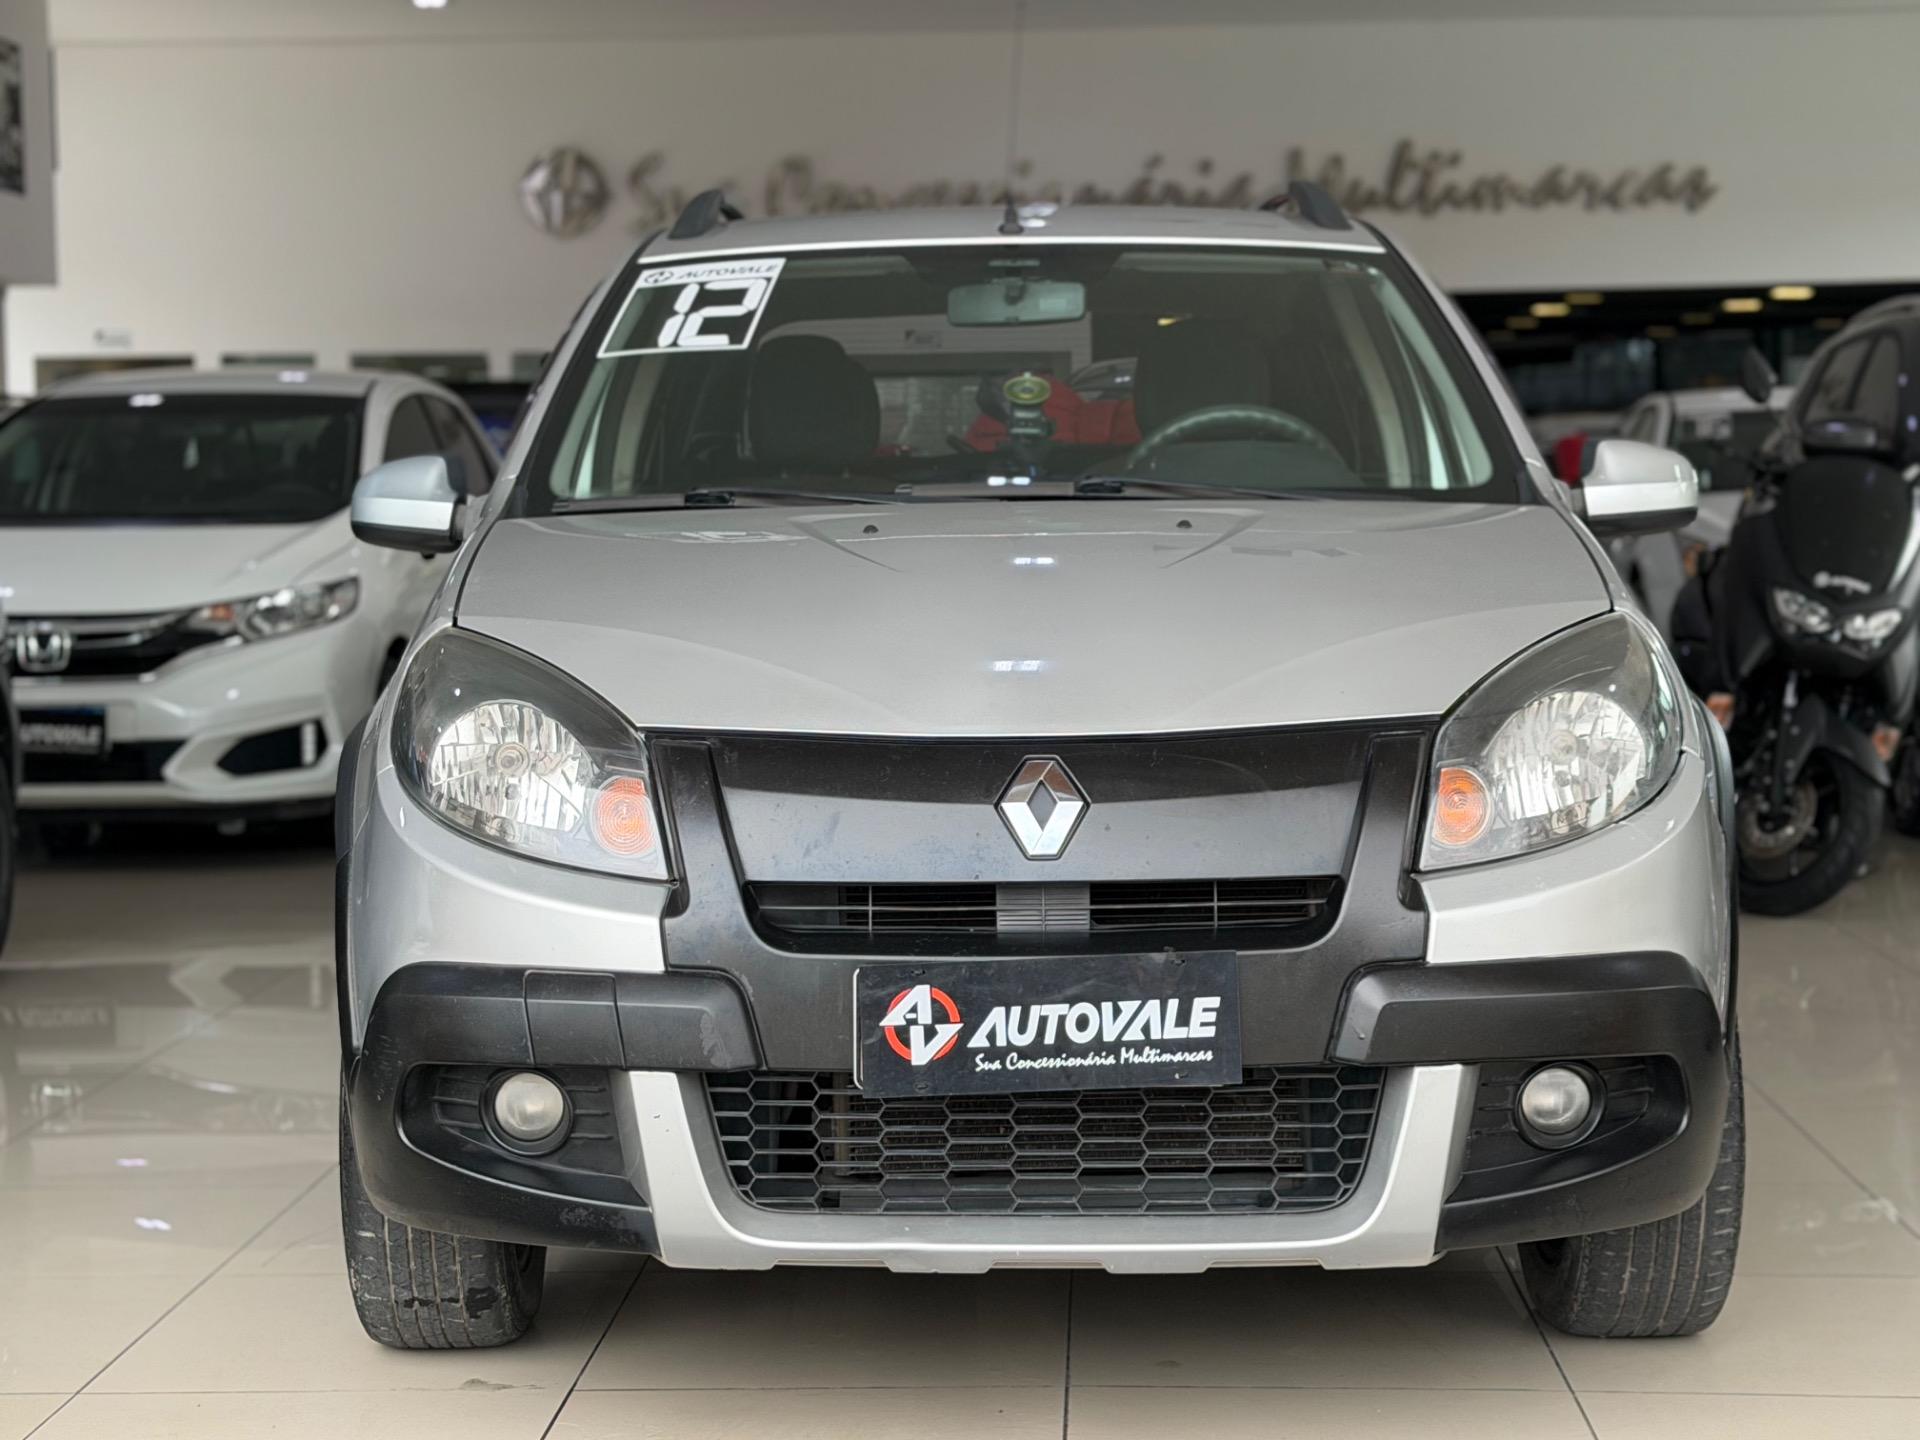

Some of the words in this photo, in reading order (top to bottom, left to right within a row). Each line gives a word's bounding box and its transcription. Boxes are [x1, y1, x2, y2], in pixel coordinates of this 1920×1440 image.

[657, 277, 768, 348] 12
[966, 996, 1221, 1048] AUTOVALE
[974, 1052, 1002, 1073] Sua
[1006, 1051, 1116, 1071] Concessionária
[1120, 1046, 1214, 1065] Multimarcas
